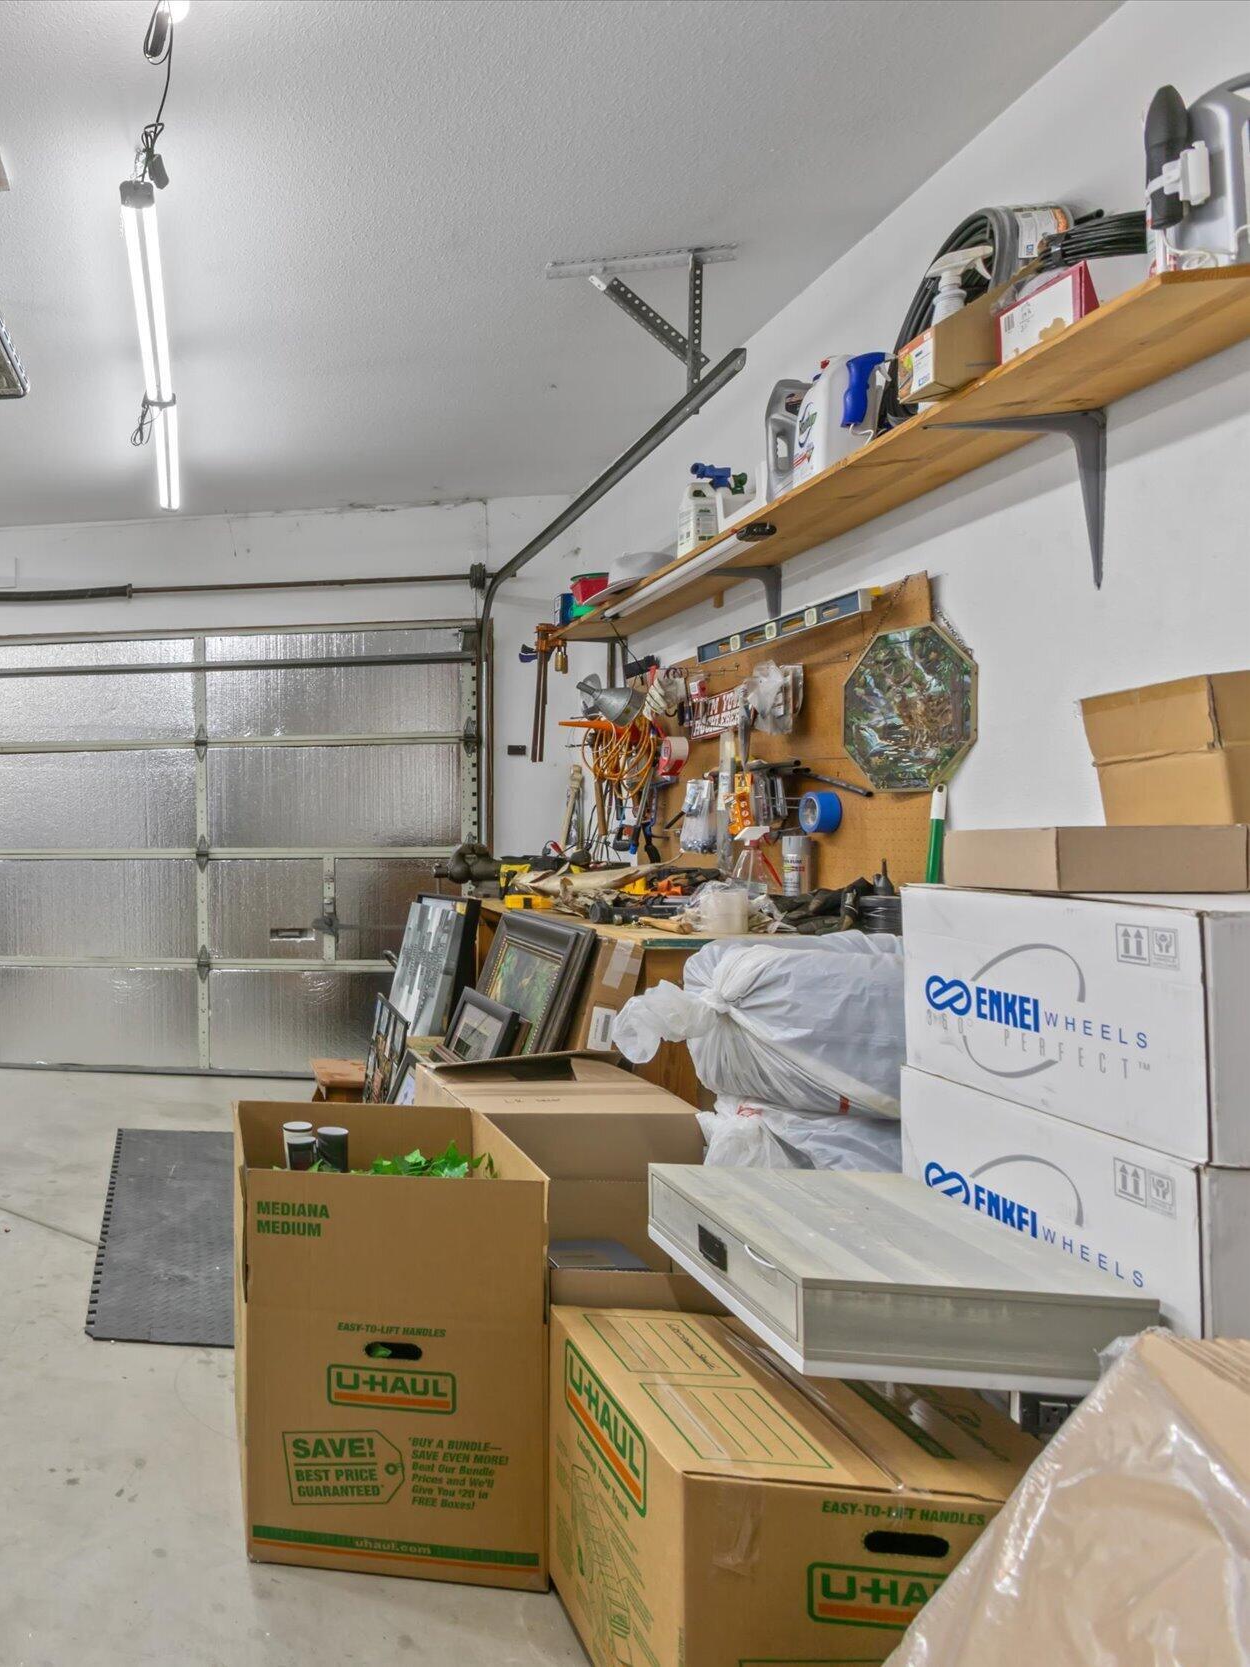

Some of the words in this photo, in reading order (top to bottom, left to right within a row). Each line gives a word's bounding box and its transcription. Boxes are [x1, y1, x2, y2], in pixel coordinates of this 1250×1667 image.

[975, 986, 1040, 1033] ENKEI
[1044, 1011, 1148, 1049] WHEELS
[257, 1201, 330, 1219] MEDIANA
[257, 1220, 321, 1237] MEDIUM
[1042, 1225, 1144, 1288] WHEELS
[337, 1322, 400, 1335] EASY-TO-LIFT
[402, 1327, 446, 1338] HANDLES
[336, 1371, 449, 1398] U-HAUL
[569, 1353, 640, 1480] U-HAUL
[292, 1437, 376, 1459] SAVE!
[436, 1439, 444, 1449] A
[412, 1450, 439, 1461] SAVE
[442, 1452, 470, 1463] EVEN
[473, 1454, 509, 1466] MORE!
[295, 1469, 330, 1482] BEST
[335, 1468, 378, 1481] PRICE
[412, 1462, 435, 1472] Beat
[438, 1464, 456, 1474] Our
[459, 1465, 495, 1477] Bundle
[412, 1474, 443, 1485] Prices
[447, 1477, 466, 1486] and
[469, 1478, 495, 1488] We'll
[412, 1485, 433, 1495] Give
[438, 1487, 455, 1497] You
[412, 1496, 438, 1507] FREE
[440, 1499, 476, 1510] Boxes!
[920, 1509, 986, 1526] HANDLES
[355, 1538, 432, 1554] uhaul.com
[821, 1574, 941, 1607] U-HA
